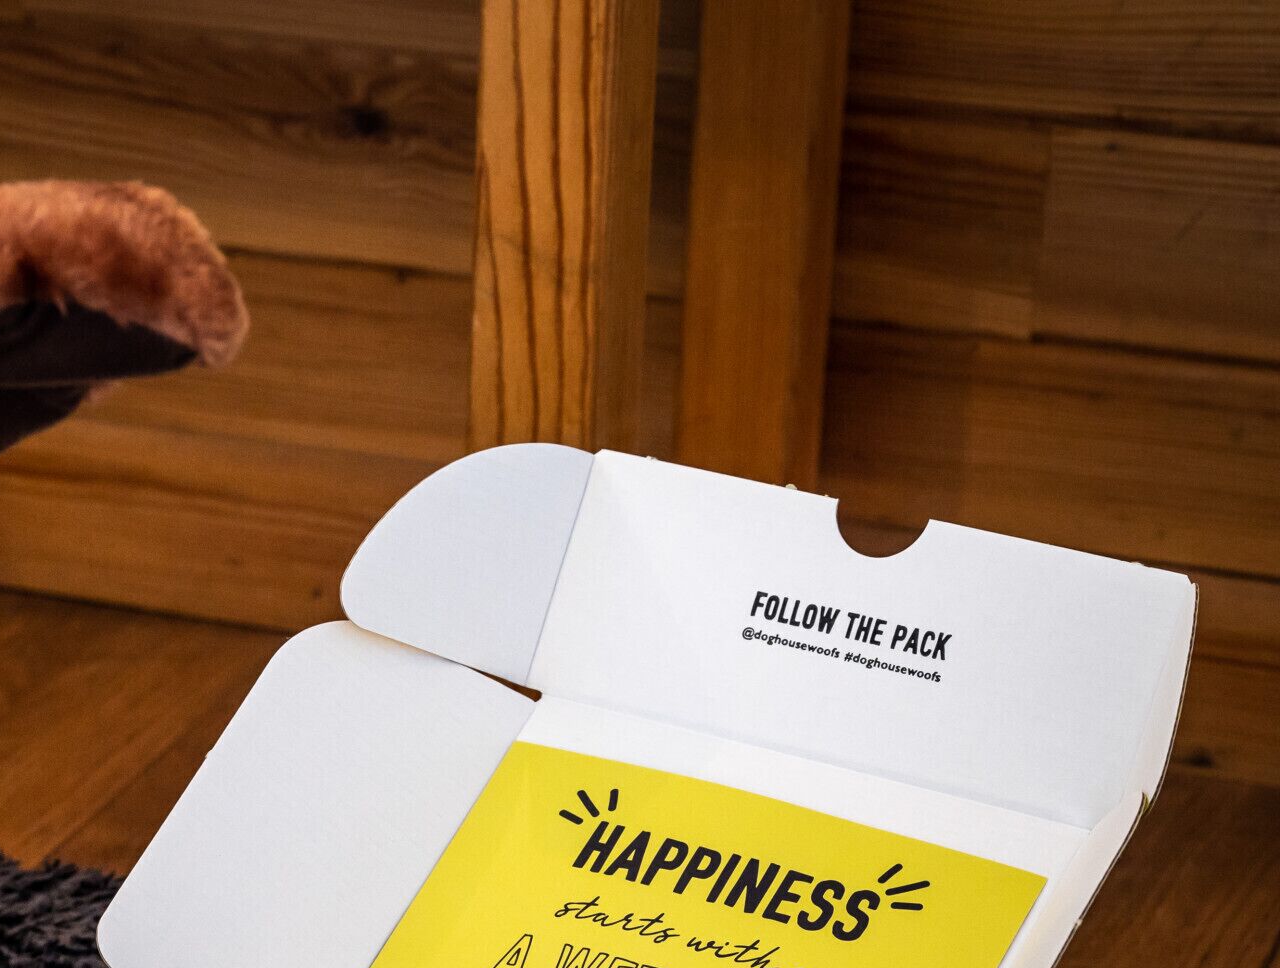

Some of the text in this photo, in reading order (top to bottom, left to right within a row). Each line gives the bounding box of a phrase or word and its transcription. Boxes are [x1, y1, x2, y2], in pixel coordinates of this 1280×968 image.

[741, 627, 942, 682] @doghousewoofs #doghousewoofs
[750, 591, 952, 660] FOLLOW THE PACK
[573, 820, 881, 941] HAPPINESS
[554, 895, 679, 944] starts
